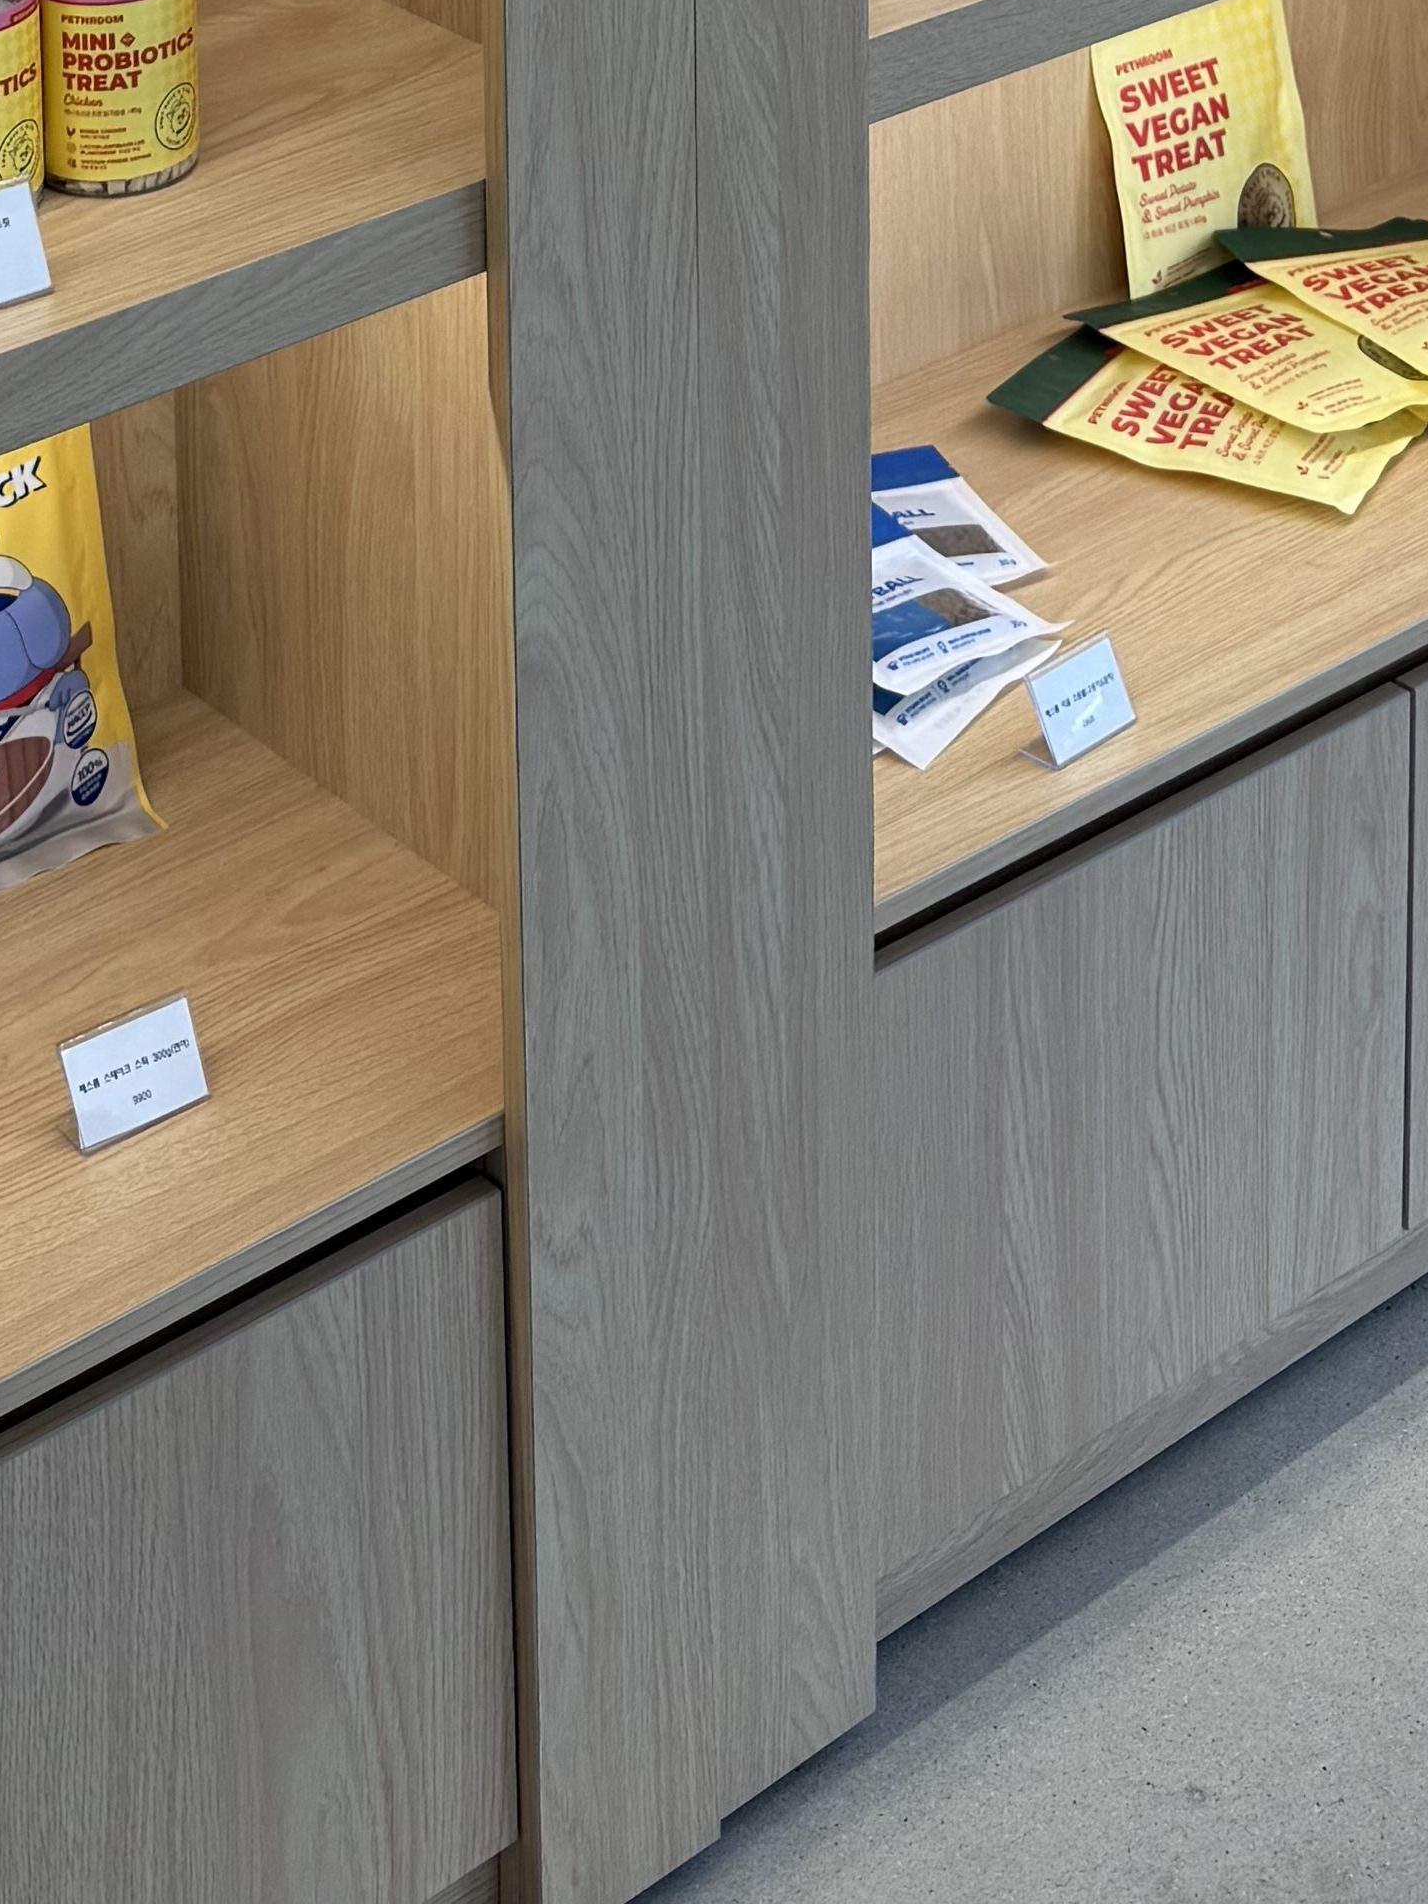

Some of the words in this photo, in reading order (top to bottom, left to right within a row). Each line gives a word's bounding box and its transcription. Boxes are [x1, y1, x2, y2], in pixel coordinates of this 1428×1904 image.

[62, 31, 116, 51] MINI
[62, 27, 194, 72] PROBIOTICS
[62, 70, 142, 92] TREAT
[1119, 57, 1220, 114] SWEET
[1125, 92, 1231, 149] VEGAN
[1131, 127, 1227, 183] TREAT
[1302, 254, 1421, 292] SWEET
[1160, 303, 1274, 349] SWEET
[1183, 312, 1304, 359] VEGAN
[1208, 324, 1315, 370] TREAT
[1110, 364, 1178, 437] SWEE
[1145, 379, 1209, 445] VEGA
